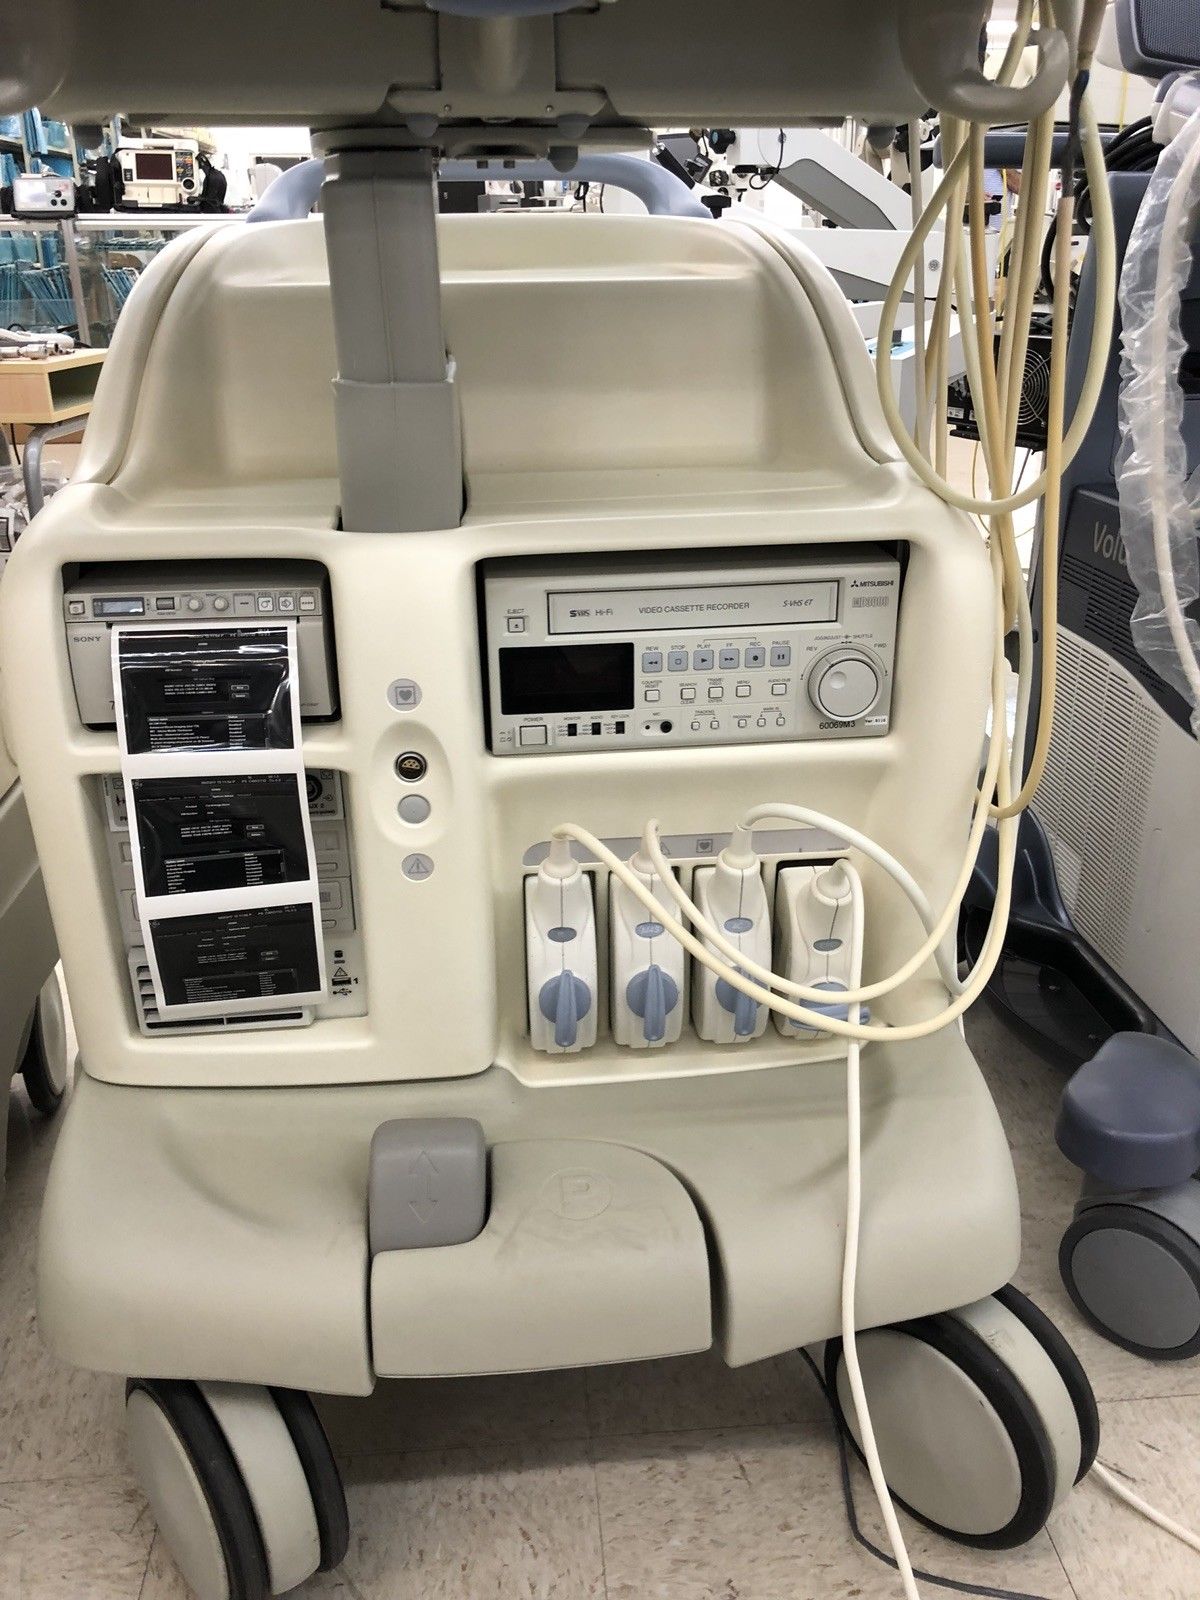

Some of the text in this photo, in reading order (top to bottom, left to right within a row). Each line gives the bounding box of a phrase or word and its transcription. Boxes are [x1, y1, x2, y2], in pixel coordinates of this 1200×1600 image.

[859, 580, 894, 588] MITSUBISHI
[804, 598, 814, 607] ET
[595, 608, 614, 617] Hi-Fi
[638, 601, 750, 615] VIDEO CASSETTE RECORDER
[819, 720, 856, 730] 60069M3
